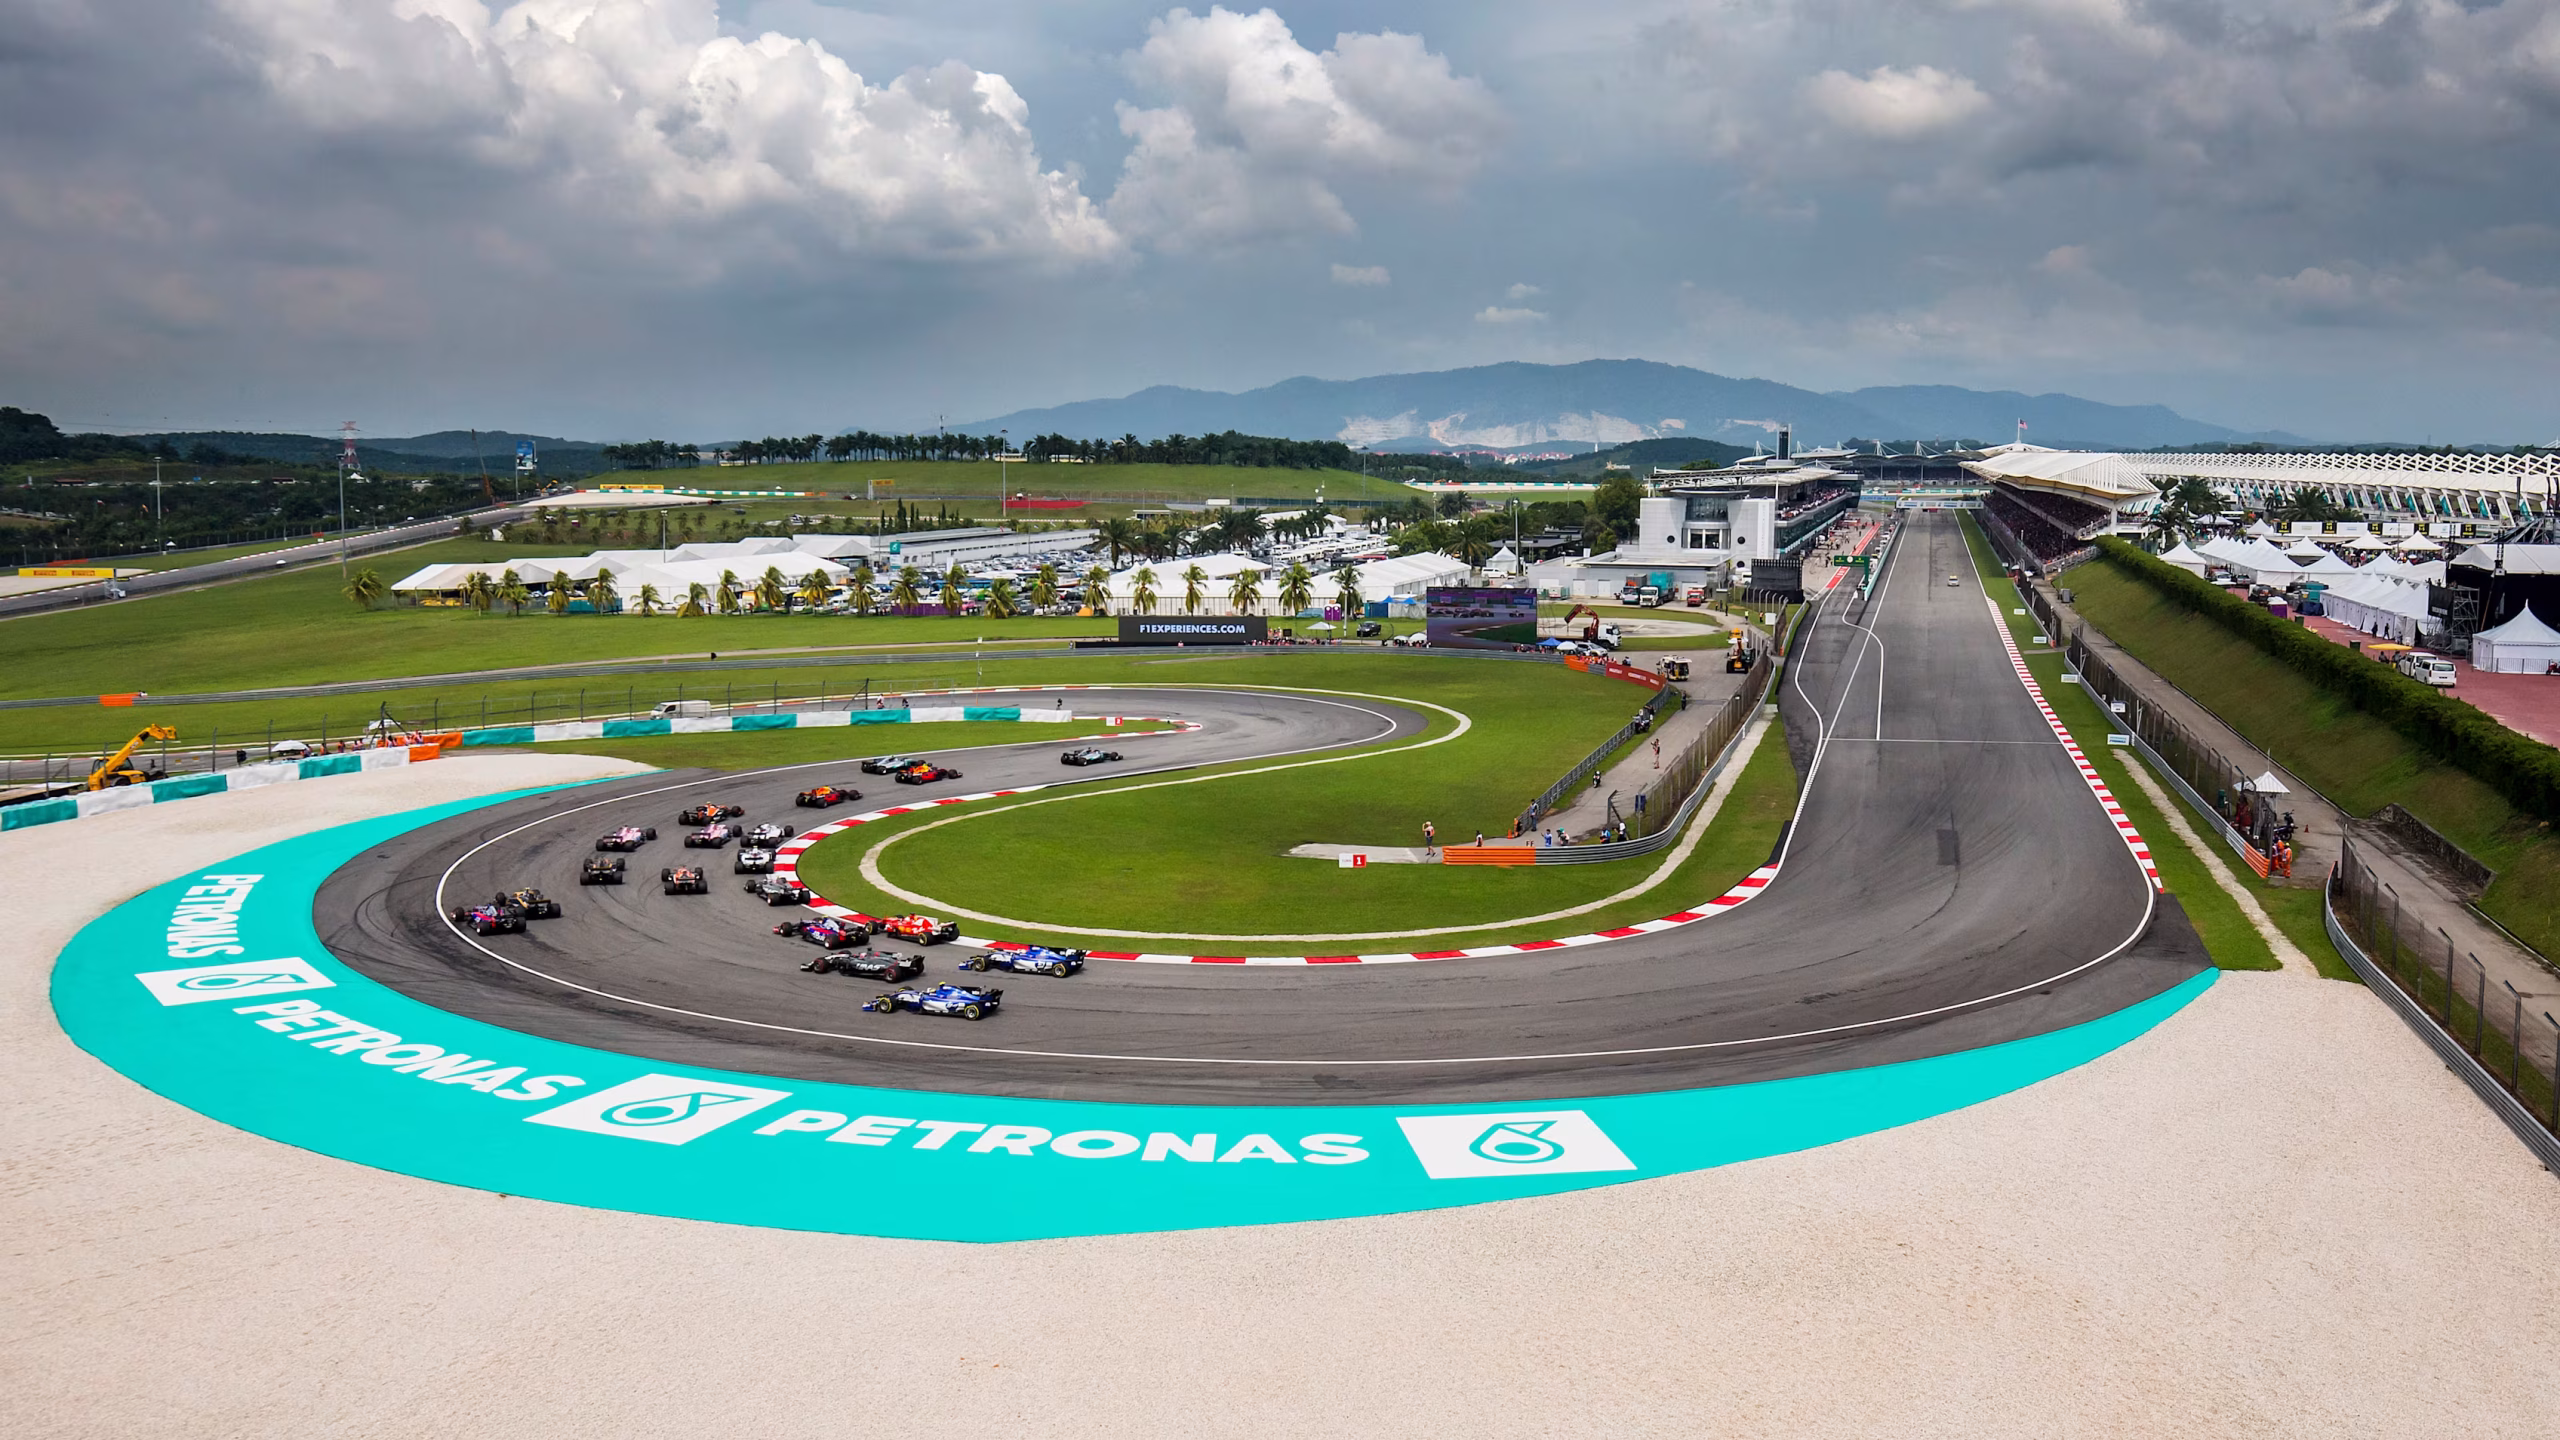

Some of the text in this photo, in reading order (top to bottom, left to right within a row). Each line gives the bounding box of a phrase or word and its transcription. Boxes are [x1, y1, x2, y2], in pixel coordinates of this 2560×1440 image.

[1139, 624, 1246, 634] F1EXPERIENCES.COM
[167, 874, 264, 958] PETRONAS
[232, 999, 586, 1101] PETRONAS
[752, 1109, 1370, 1165] PETRONAS
